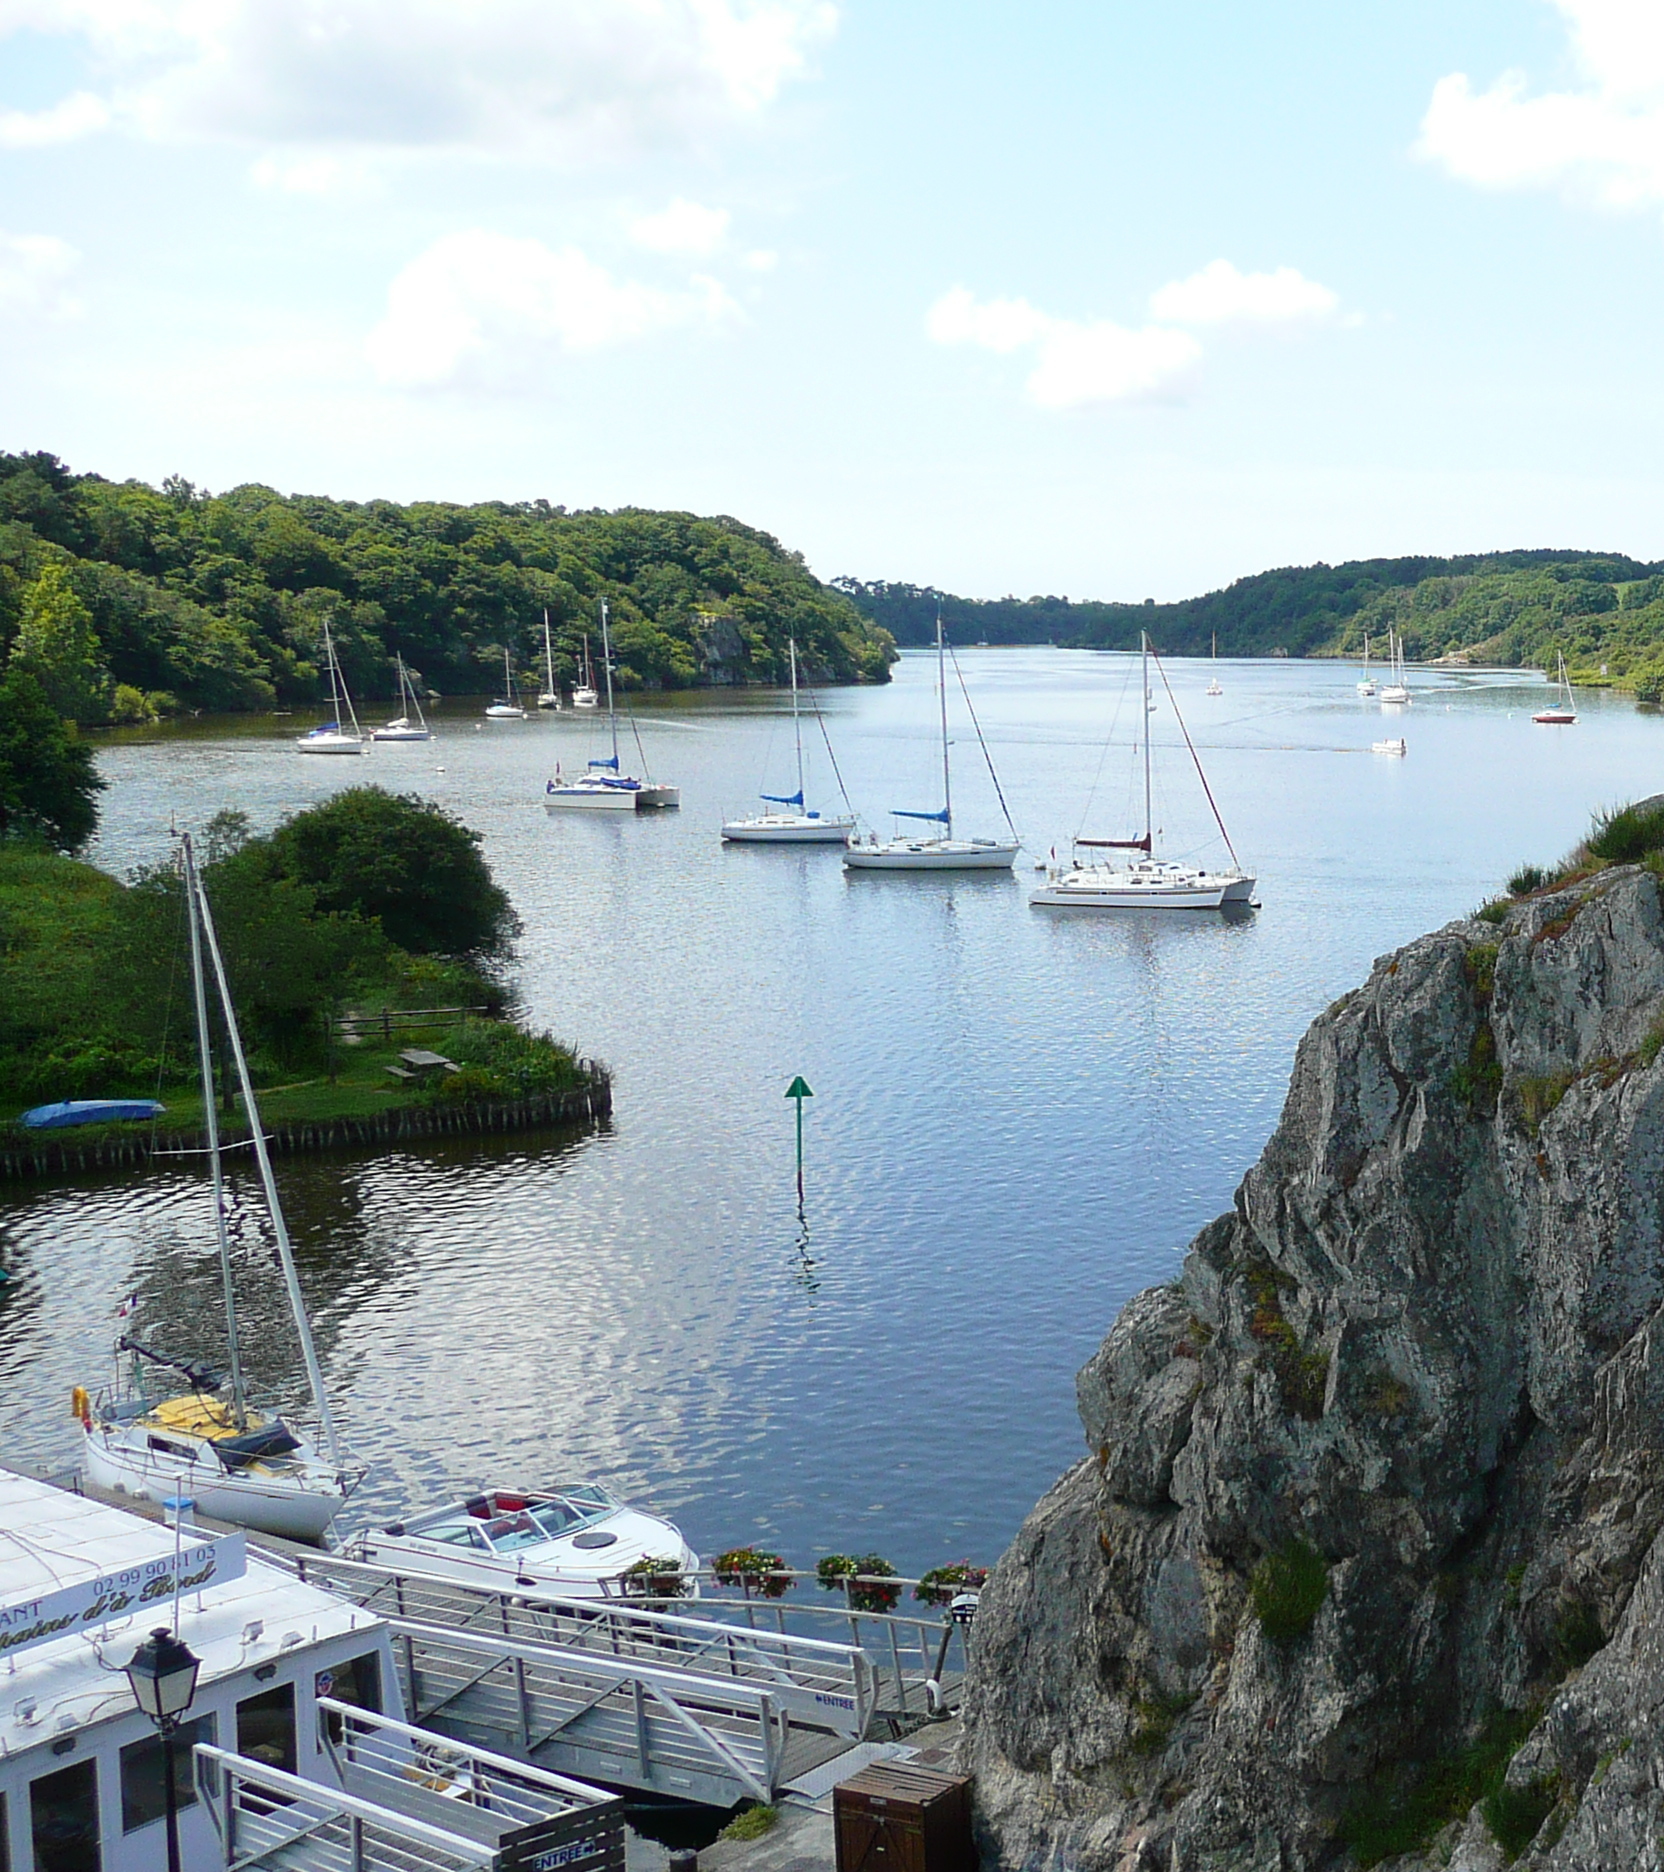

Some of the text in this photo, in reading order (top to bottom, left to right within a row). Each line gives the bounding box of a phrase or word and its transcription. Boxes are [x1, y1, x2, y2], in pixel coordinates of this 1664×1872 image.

[93, 1578, 115, 1596] 02
[119, 1569, 141, 1588] 99
[145, 1561, 167, 1579] 90
[197, 1545, 216, 1562] 03
[139, 1560, 217, 1602] Bord
[534, 1846, 582, 1870] ENTREE
